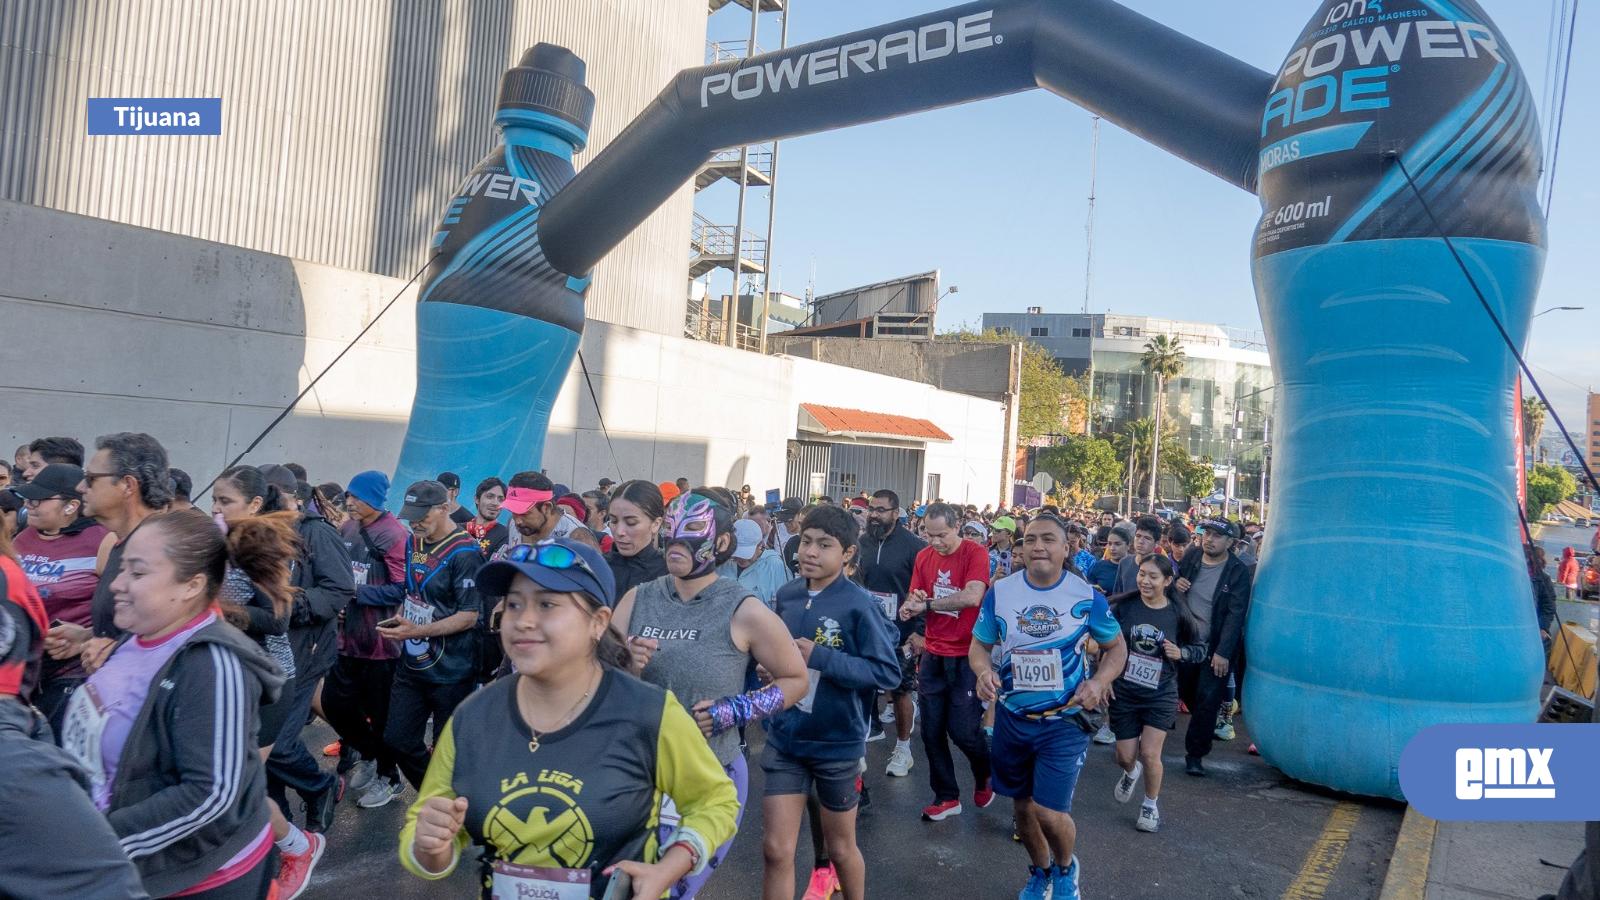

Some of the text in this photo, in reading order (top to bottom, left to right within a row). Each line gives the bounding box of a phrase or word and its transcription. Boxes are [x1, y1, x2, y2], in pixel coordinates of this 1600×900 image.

[1342, 16, 1374, 28] CALCIO
[1378, 9, 1428, 22] MAGNESIO
[700, 9, 994, 108] POWERADE
[1270, 20, 1506, 94] POWER
[1274, 195, 1332, 225] 600 ml
[641, 626, 698, 640] BELIEVE
[1020, 622, 1059, 634] ROSARITO
[1016, 665, 1051, 682] 1490
[1131, 663, 1157, 681] 1457
[500, 769, 584, 795] LA LIGA
